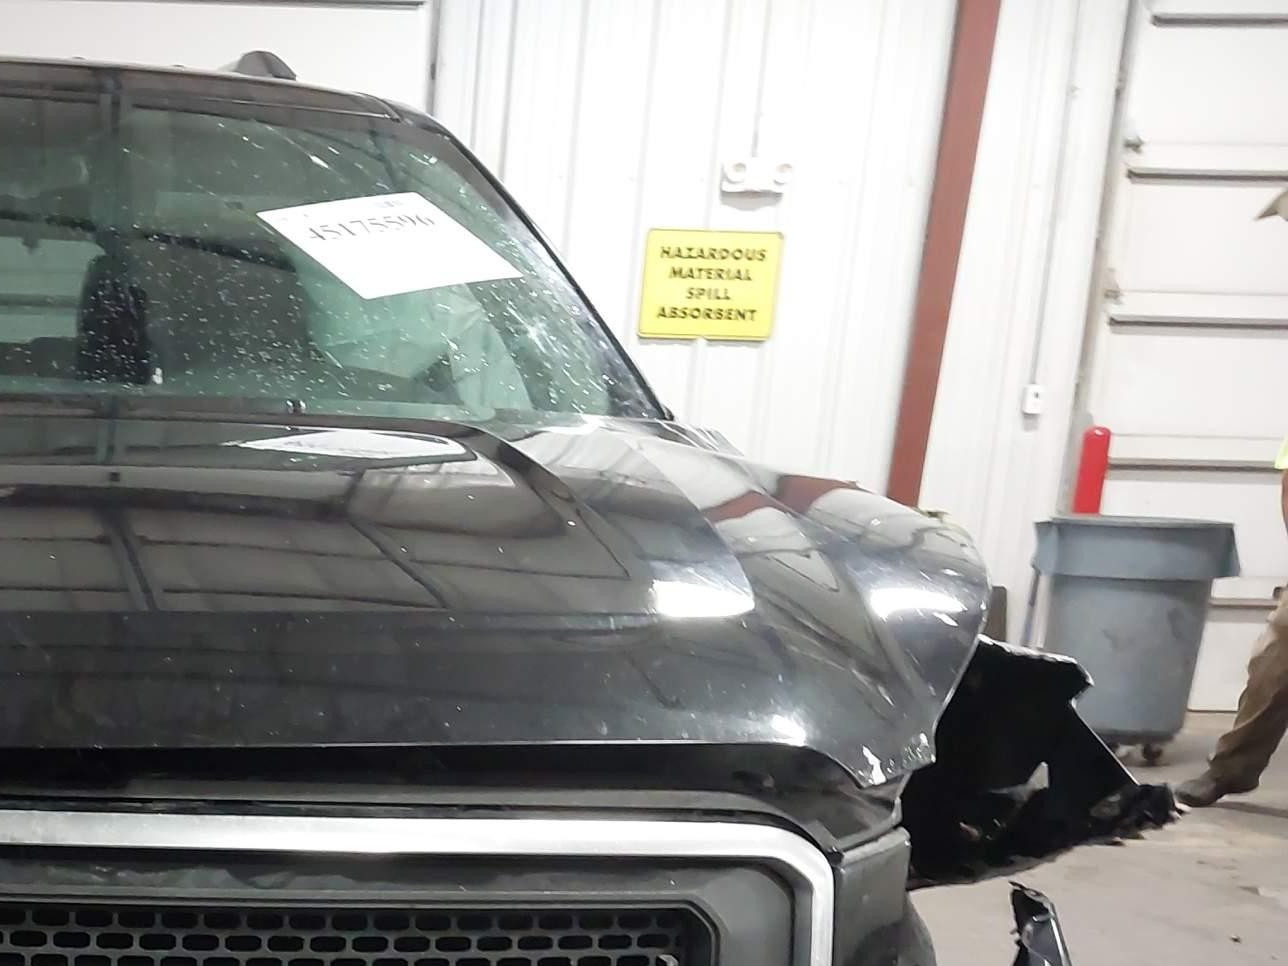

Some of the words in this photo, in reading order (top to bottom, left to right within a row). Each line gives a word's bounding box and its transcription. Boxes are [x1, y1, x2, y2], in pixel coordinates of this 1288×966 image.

[660, 246, 767, 262] HAZARDOUS
[669, 266, 753, 281] MATERIAL
[686, 287, 732, 301] SPILL
[657, 306, 758, 321] ABSORBENT
